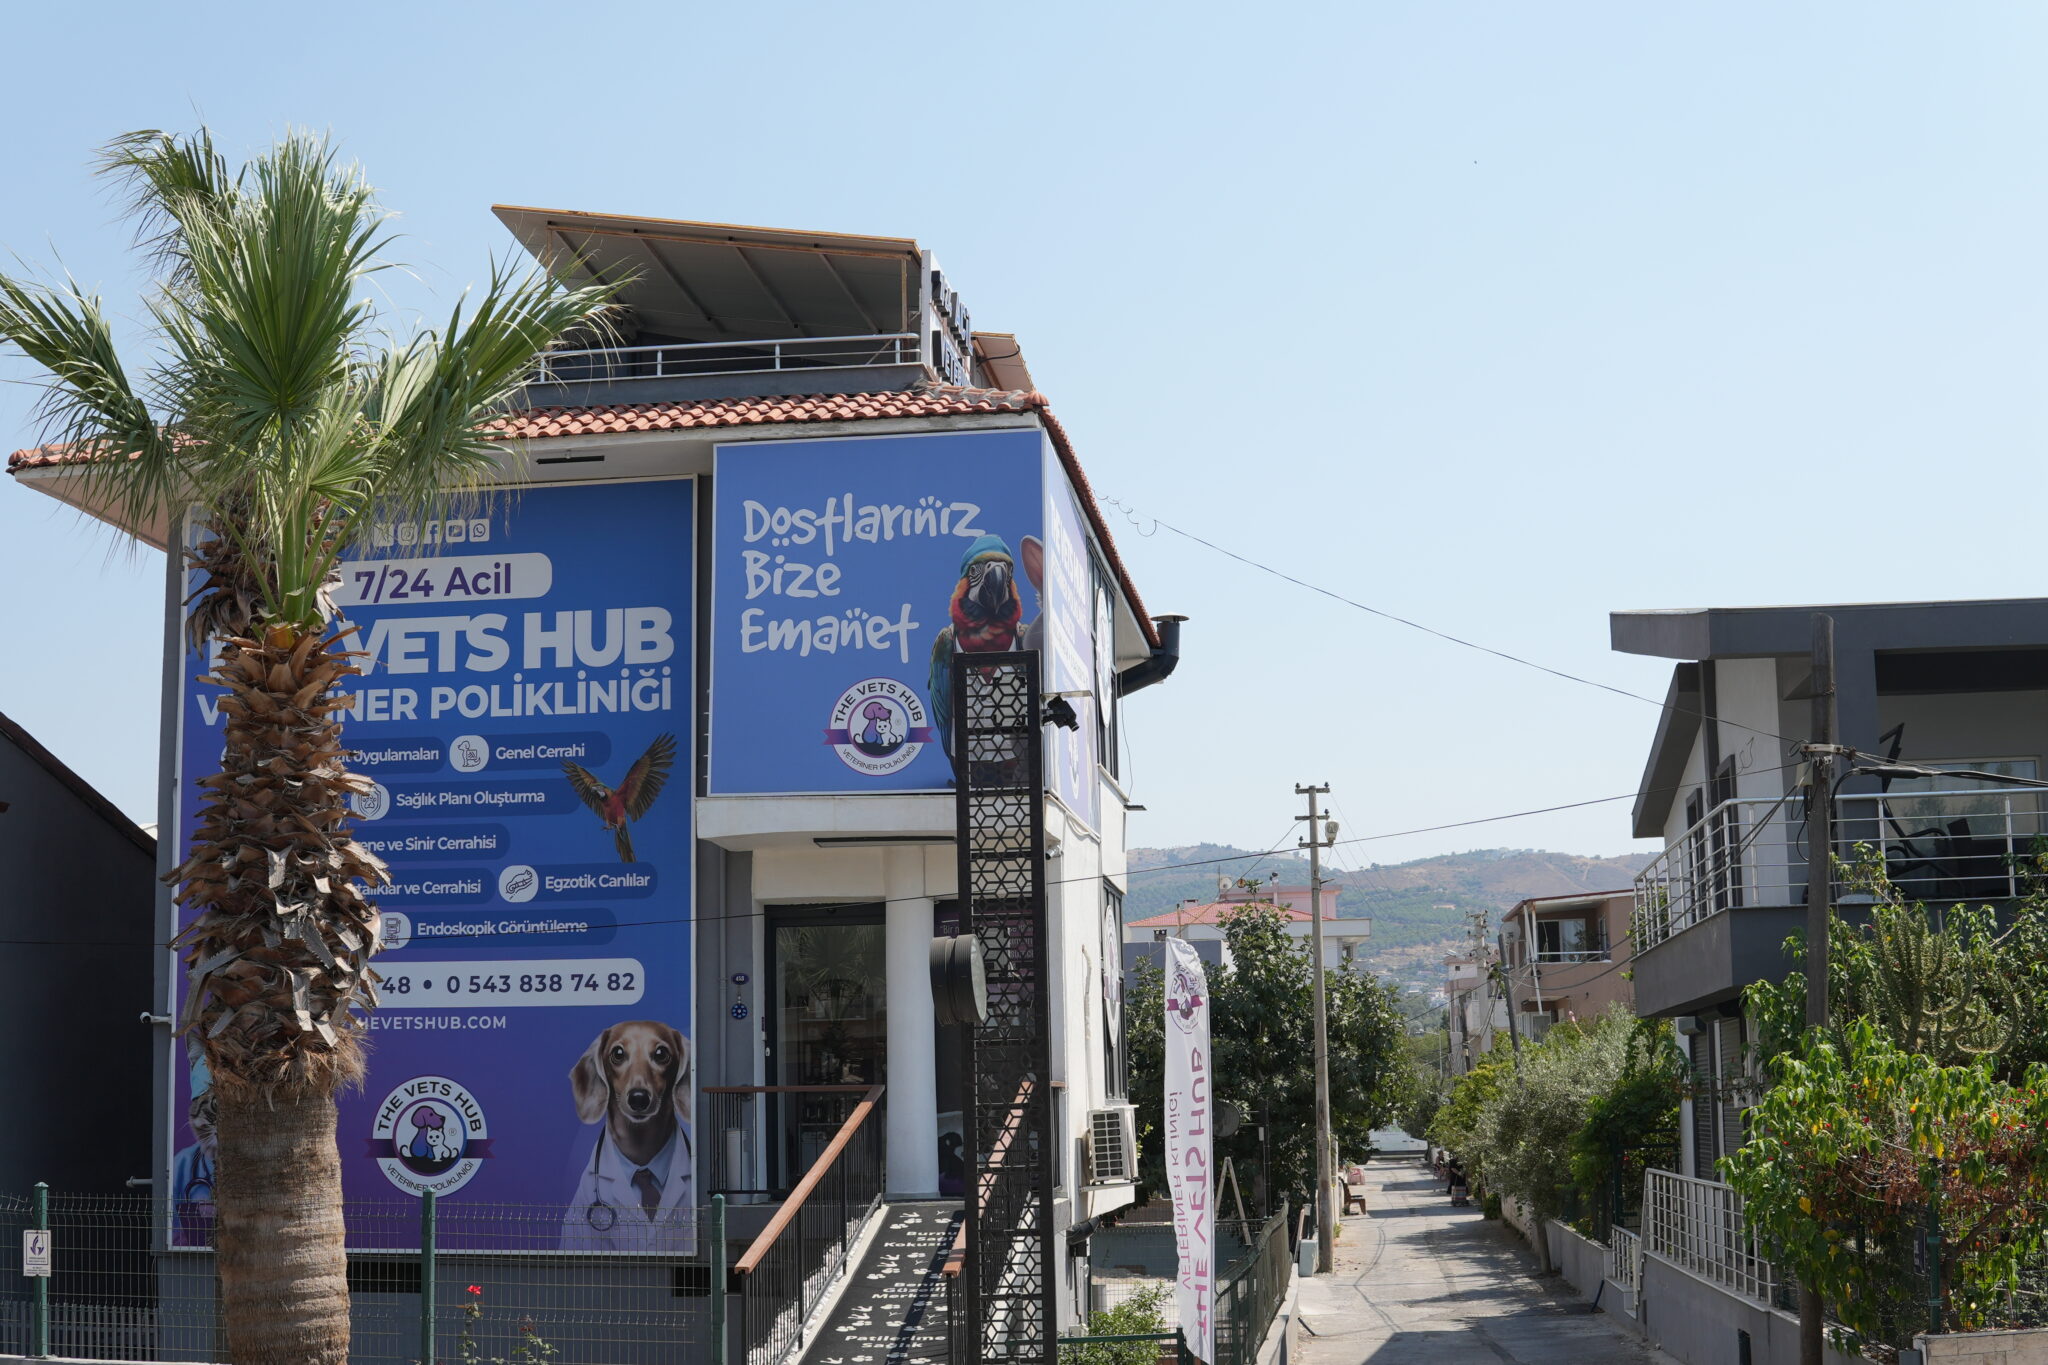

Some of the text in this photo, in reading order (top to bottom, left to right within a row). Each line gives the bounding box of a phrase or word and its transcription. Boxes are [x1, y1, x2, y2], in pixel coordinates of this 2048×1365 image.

[355, 562, 511, 604] 7/24 Acil
[742, 549, 841, 600] Bize
[336, 606, 674, 675] VETS HUB
[740, 603, 920, 664] Emanet
[430, 666, 672, 719] POLİKLİNİĞİ
[834, 682, 923, 724] THE VETS HUB
[353, 748, 439, 765] Uygulamaları
[495, 743, 585, 760] Genel Cerrahi
[396, 790, 545, 809] Sağlık Planı Oluşturma
[387, 841, 404, 851] ve
[405, 837, 435, 851] Sinir
[437, 835, 497, 850] Cerrahisi
[402, 884, 418, 895] ve
[422, 879, 482, 895] Cerrahisi
[545, 873, 651, 893] Egzotik Canlılar
[417, 920, 588, 938] Endoskopik Görüntüleme
[447, 975, 460, 994] 0
[468, 975, 511, 994] 543
[519, 974, 563, 993] 838
[570, 973, 599, 992] 74
[607, 972, 635, 991] 82
[357, 1016, 507, 1030] HEVETSHUB.COM
[377, 1081, 482, 1132] THE VETS HUB
